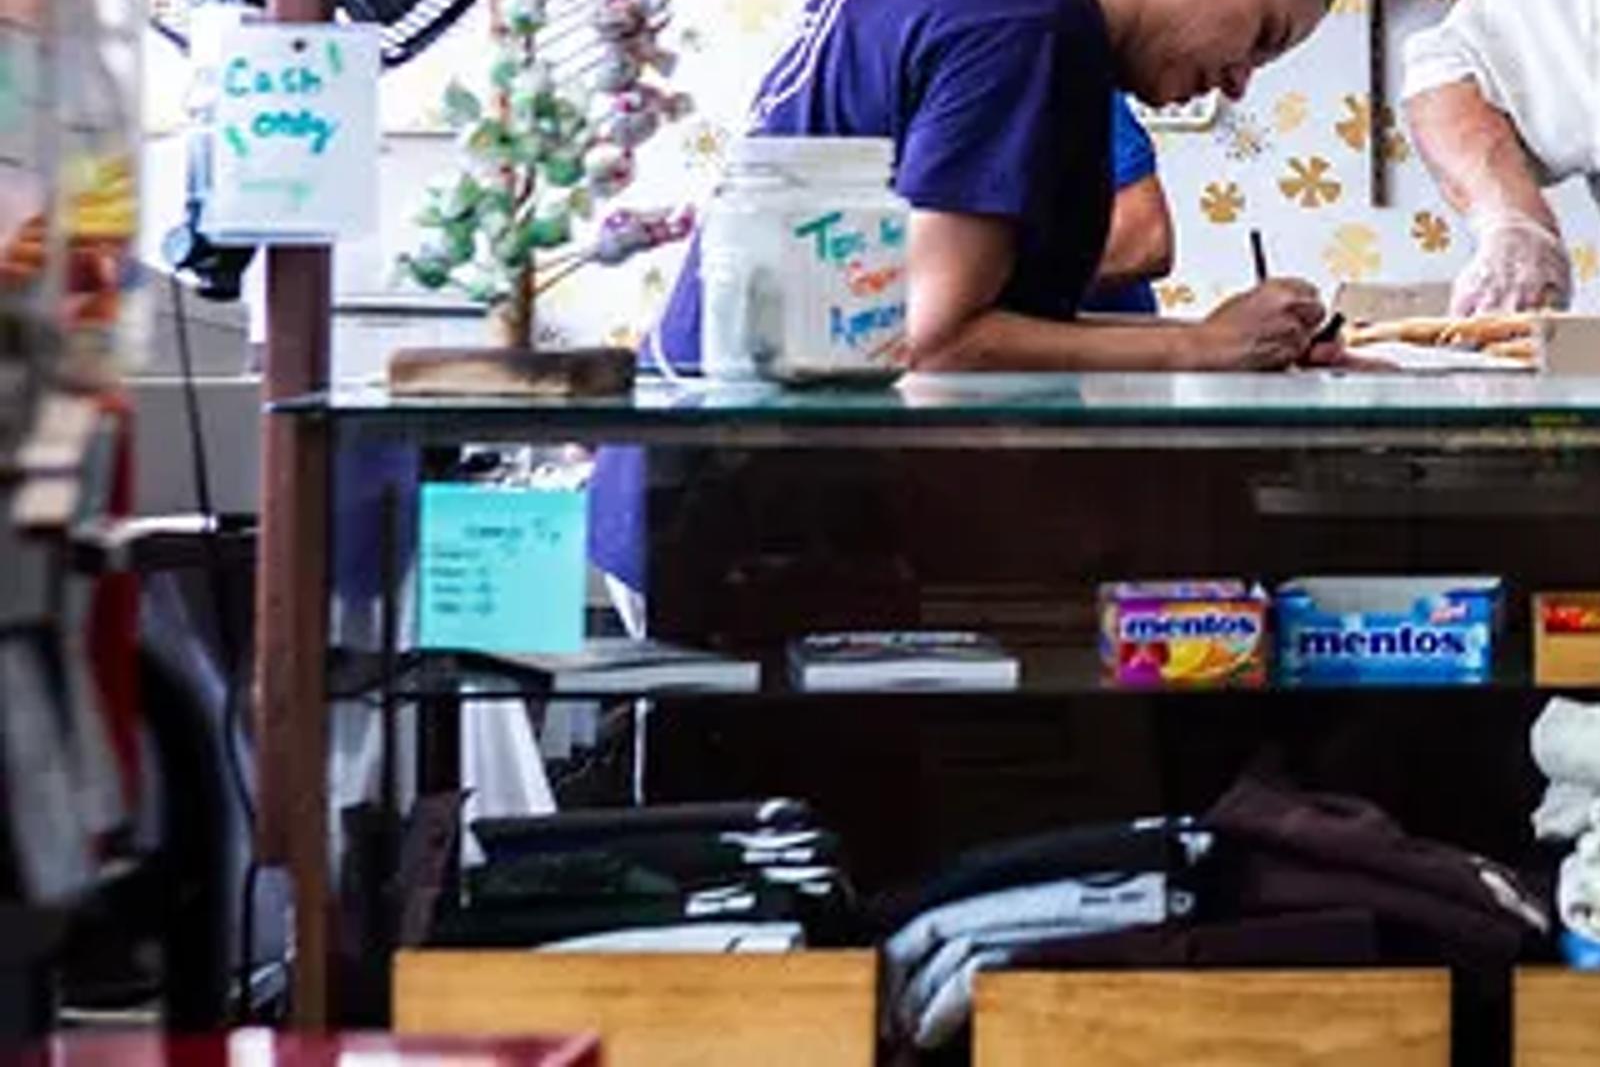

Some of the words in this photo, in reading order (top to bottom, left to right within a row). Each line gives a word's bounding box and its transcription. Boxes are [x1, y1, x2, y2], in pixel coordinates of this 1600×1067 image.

[224, 55, 322, 98] Cash
[251, 109, 338, 156] only
[1123, 611, 1259, 636] mentos
[1301, 626, 1468, 658] mentos
